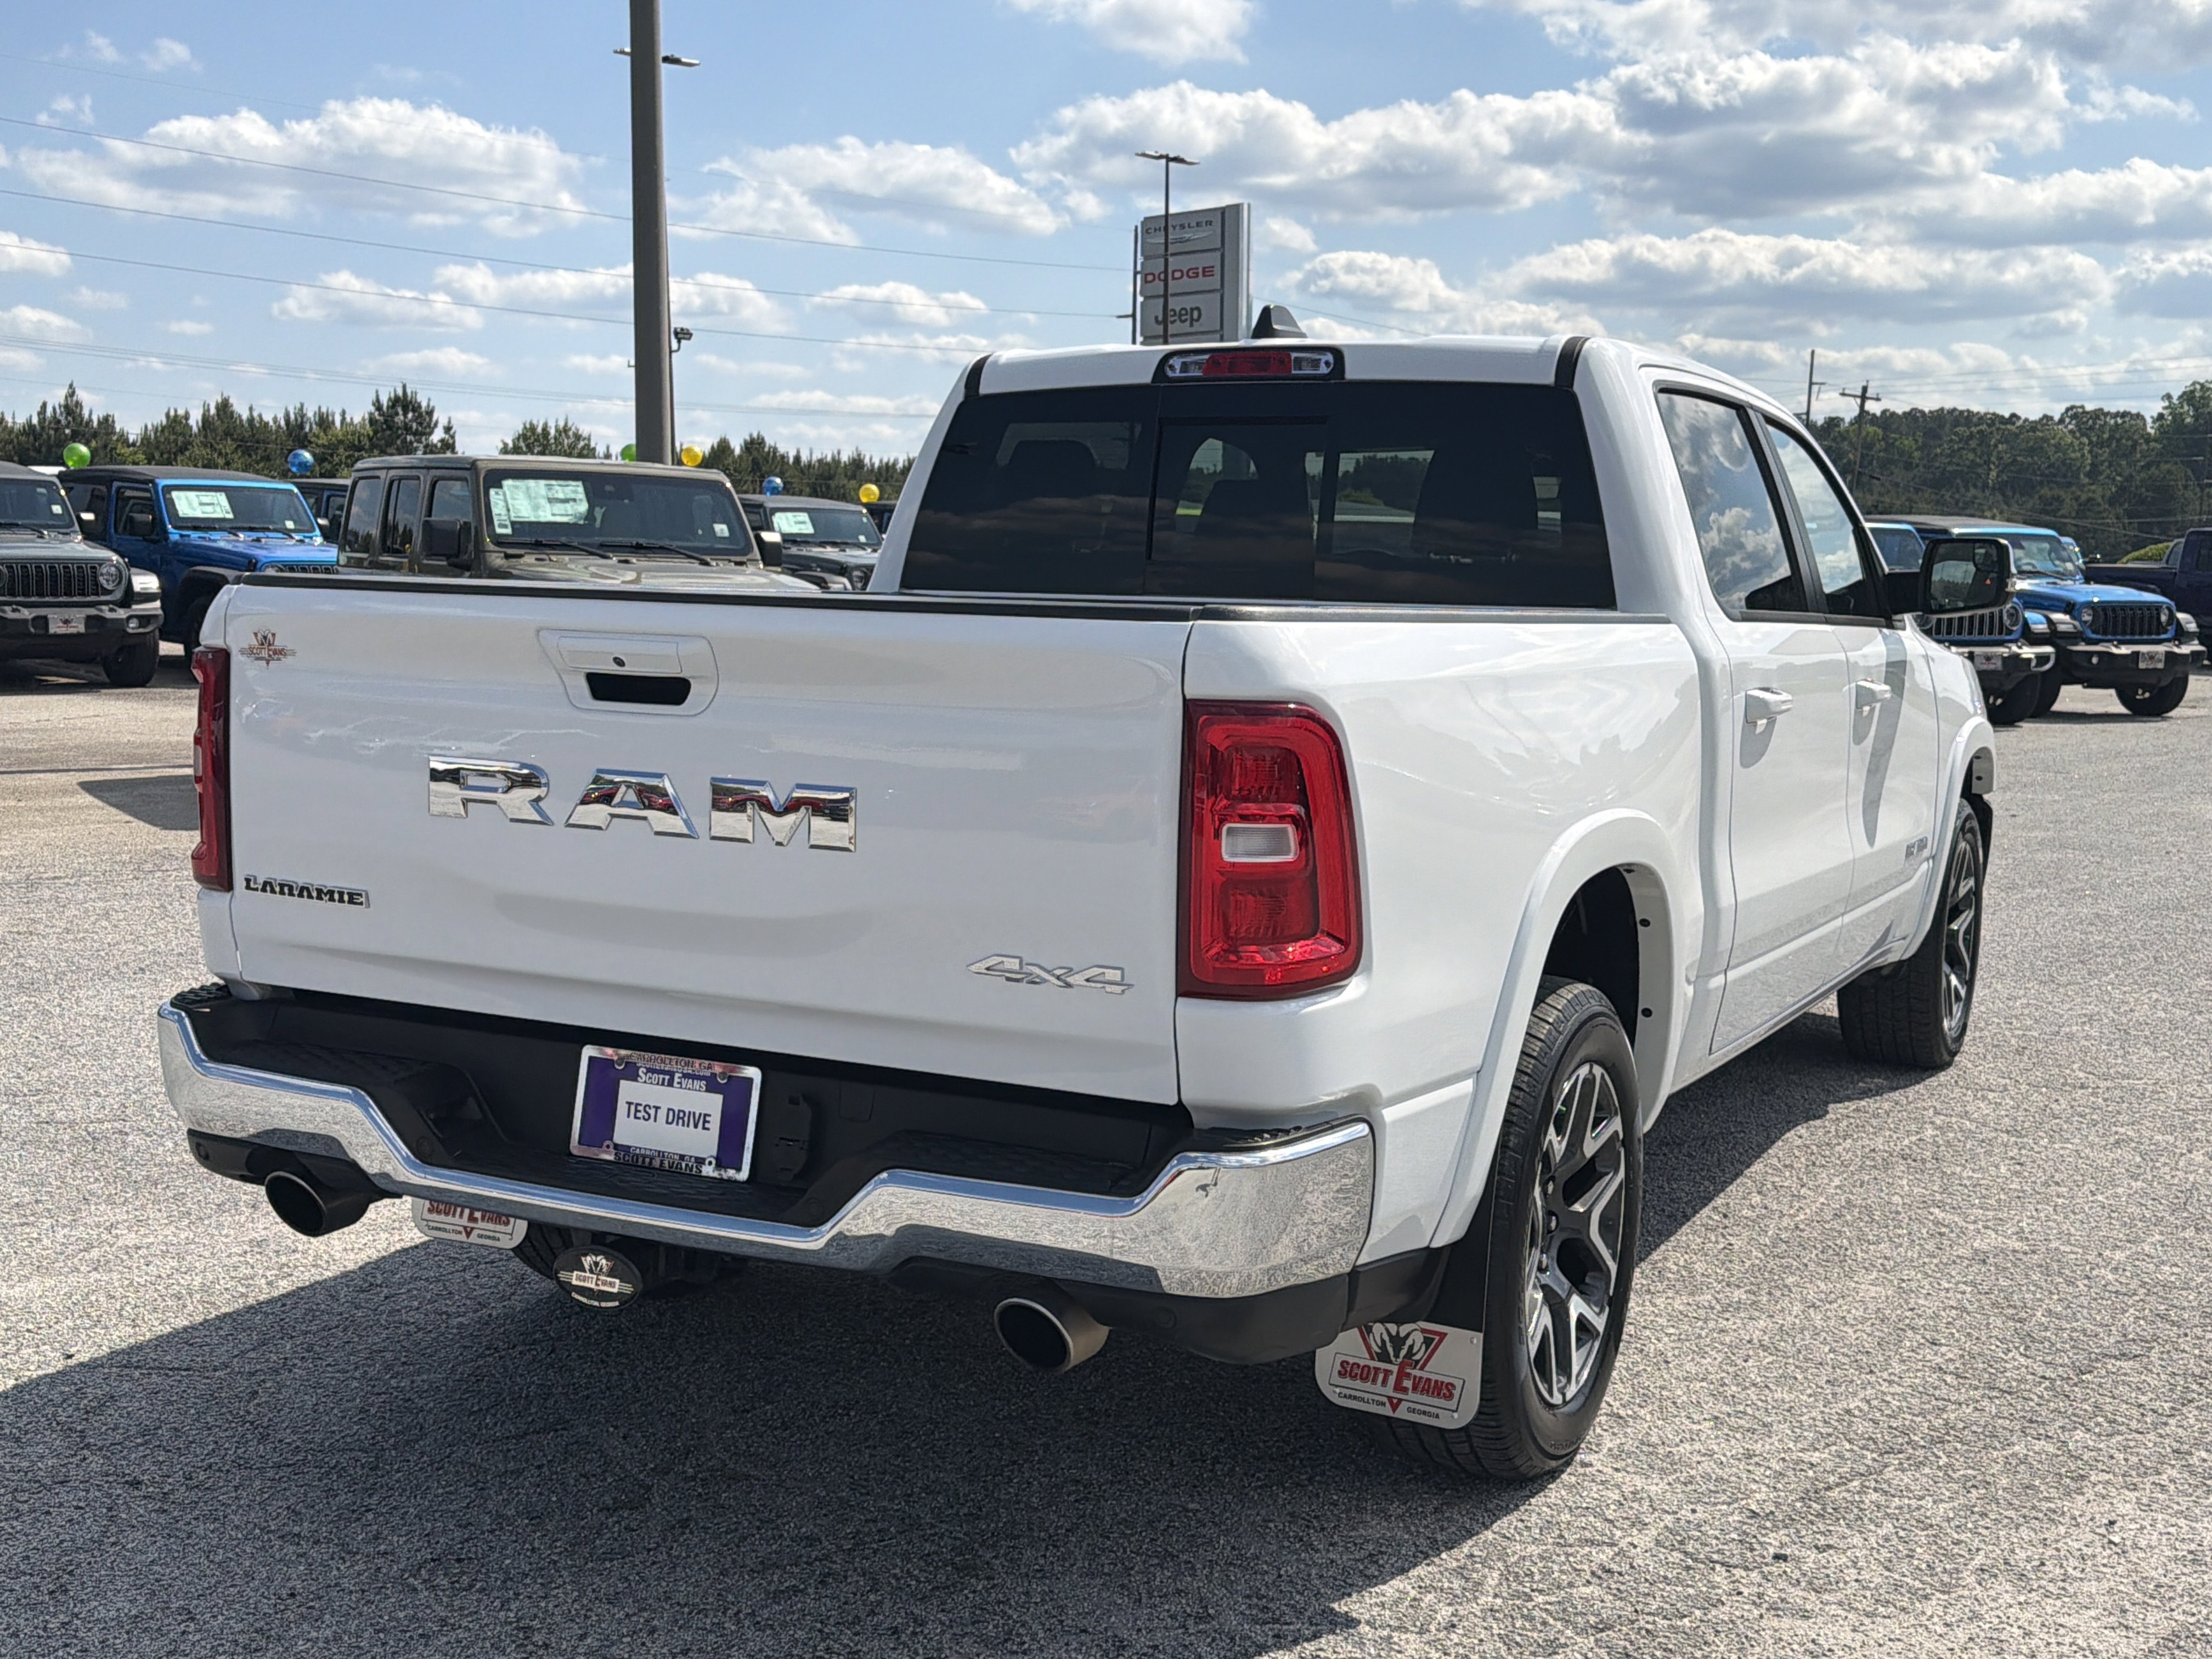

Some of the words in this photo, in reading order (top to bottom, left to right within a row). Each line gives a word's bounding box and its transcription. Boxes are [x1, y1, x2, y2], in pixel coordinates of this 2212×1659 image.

[1145, 220, 1213, 234] CHYSLER
[428, 755, 857, 852] RAM
[244, 875, 367, 907] LARAMIE
[625, 1101, 662, 1123] TEST
[665, 1108, 712, 1131] DRIVE
[614, 1152, 656, 1167] SCOTT
[659, 1159, 703, 1174] EVANS
[574, 1273, 595, 1284] SCOTT
[1337, 1359, 1393, 1387] SCOTT
[1392, 1359, 1457, 1401] EVANS
[1338, 1391, 1386, 1408] CARROLLTON
[1406, 1406, 1440, 1420] GEORGIA
